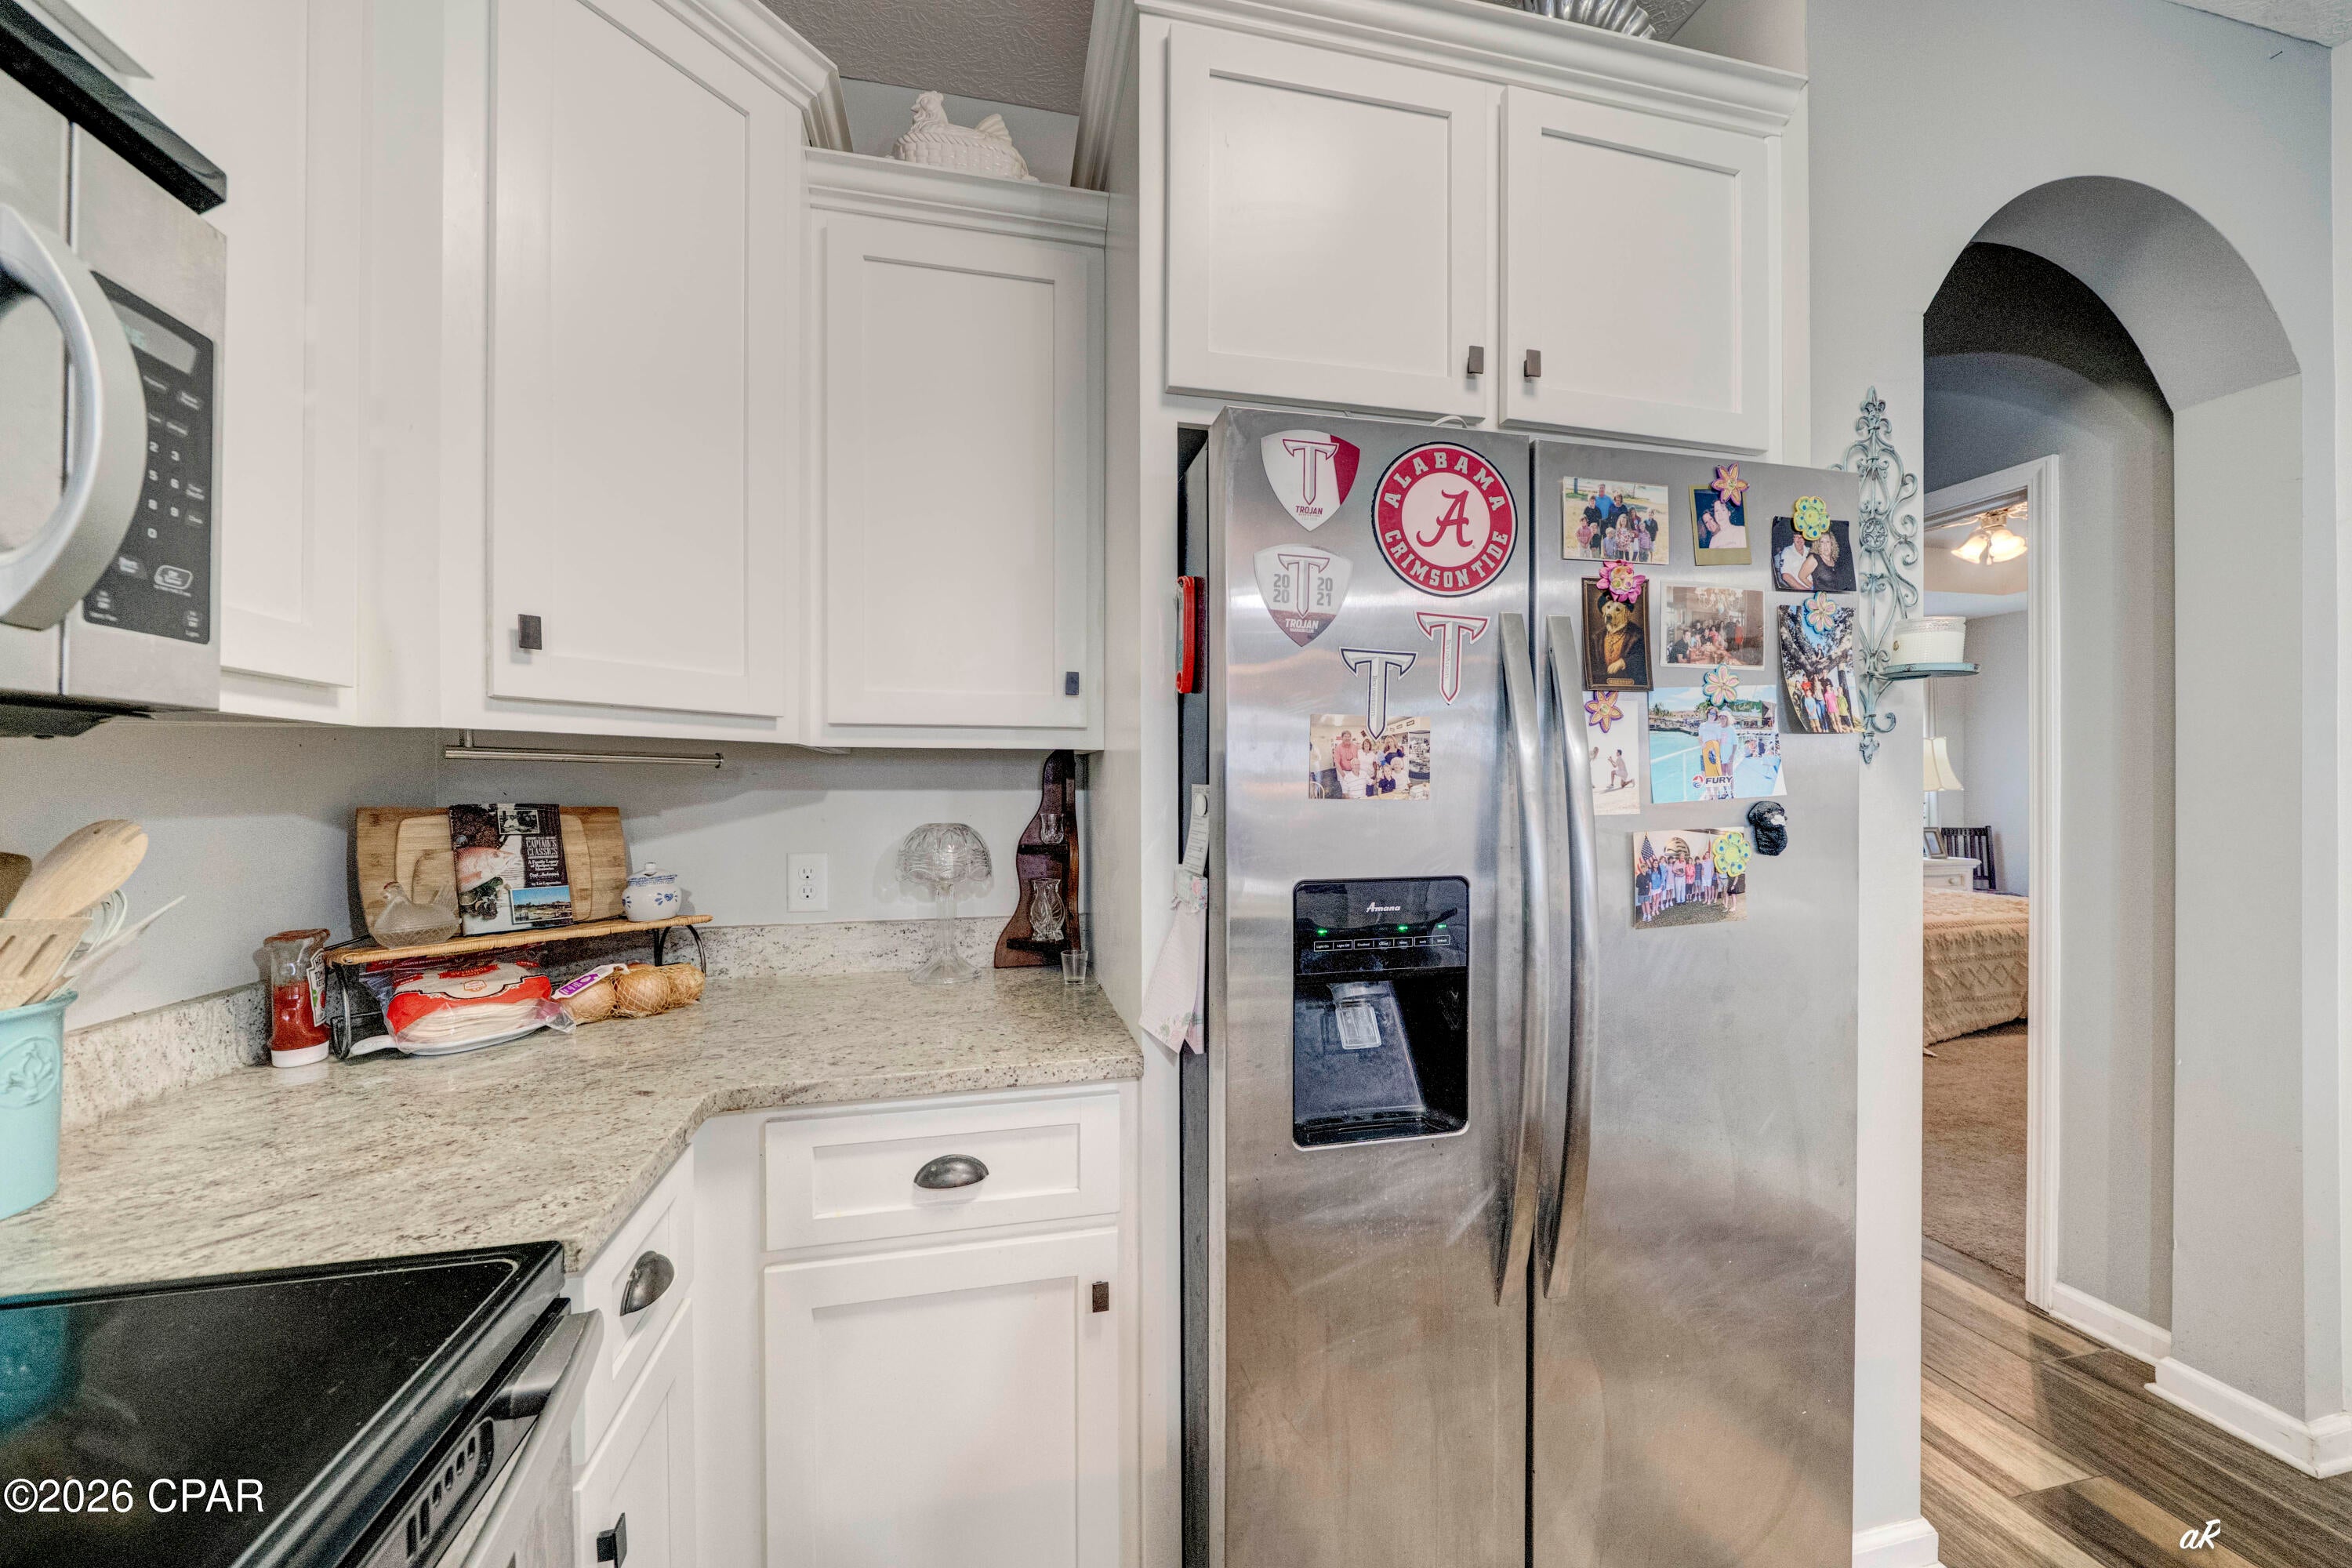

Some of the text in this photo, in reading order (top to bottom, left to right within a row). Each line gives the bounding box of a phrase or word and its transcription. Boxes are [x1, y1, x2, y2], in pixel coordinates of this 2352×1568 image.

[149, 441, 180, 462] 2 3
[149, 470, 158, 481] 5
[1384, 452, 1505, 511] ALABAMA
[1295, 505, 1323, 515] TROJAN
[1416, 489, 1473, 547] A
[1385, 529, 1508, 587] CRIMSON TIDE
[1273, 574, 1333, 592] 20 20
[1272, 589, 1331, 607] 20 21
[1285, 618, 1319, 630] TROJAN
[527, 848, 558, 856] CLASSICS
[1366, 902, 1401, 913] Amana
